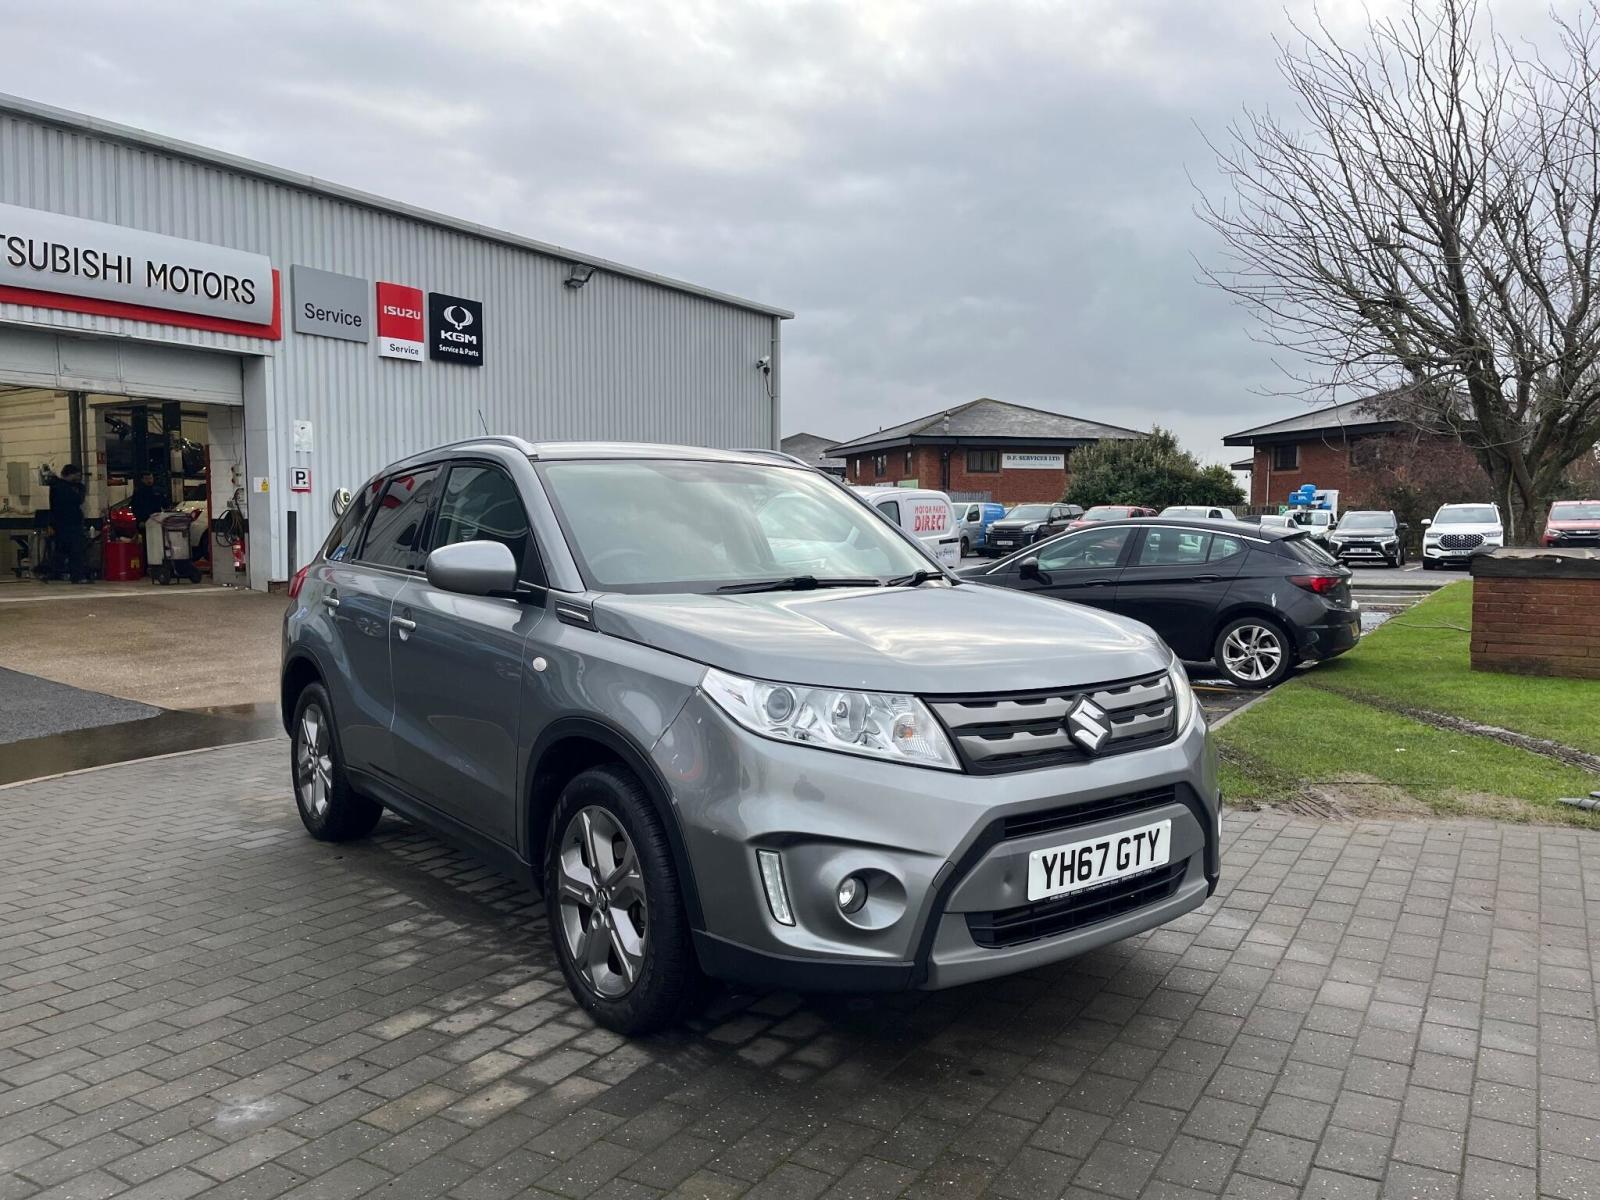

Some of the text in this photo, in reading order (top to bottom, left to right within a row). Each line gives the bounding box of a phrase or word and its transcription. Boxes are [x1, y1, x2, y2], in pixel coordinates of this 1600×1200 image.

[146, 260, 255, 304] MOTORS
[304, 302, 362, 327] Service
[383, 305, 421, 320] ISUZU
[440, 330, 477, 344] KGM
[389, 343, 419, 355] Service
[438, 344, 479, 357] Service & Parts
[295, 470, 306, 485] P
[913, 514, 946, 532] DIRECT
[1041, 841, 1110, 890] YH67
[1116, 828, 1161, 871] GTY
